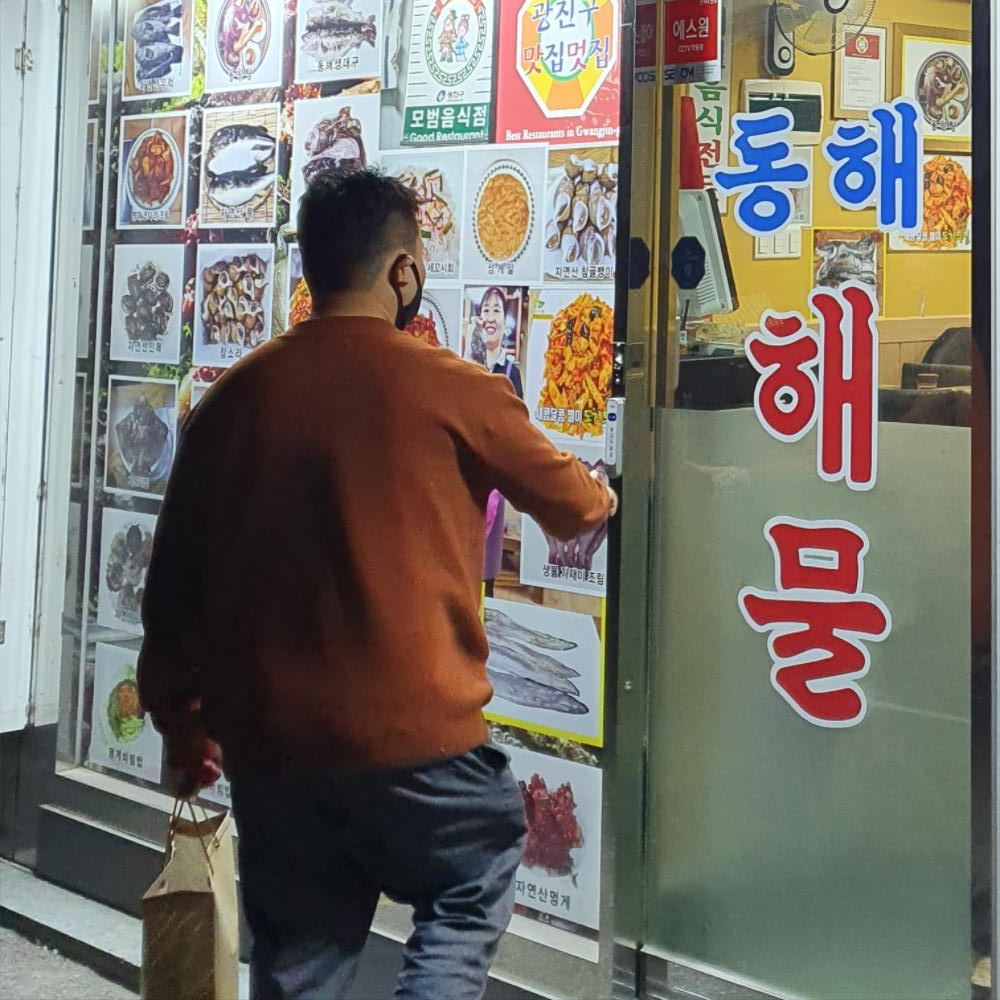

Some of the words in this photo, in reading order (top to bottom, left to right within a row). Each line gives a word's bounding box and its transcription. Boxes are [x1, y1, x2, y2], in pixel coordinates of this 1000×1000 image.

[672, 16, 710, 41] 에스원
[410, 106, 488, 129] 모범음식점
[410, 131, 435, 142] Good
[713, 95, 923, 236] 동해
[555, 264, 579, 279] 자연산
[515, 880, 570, 911] 자연산멍게
